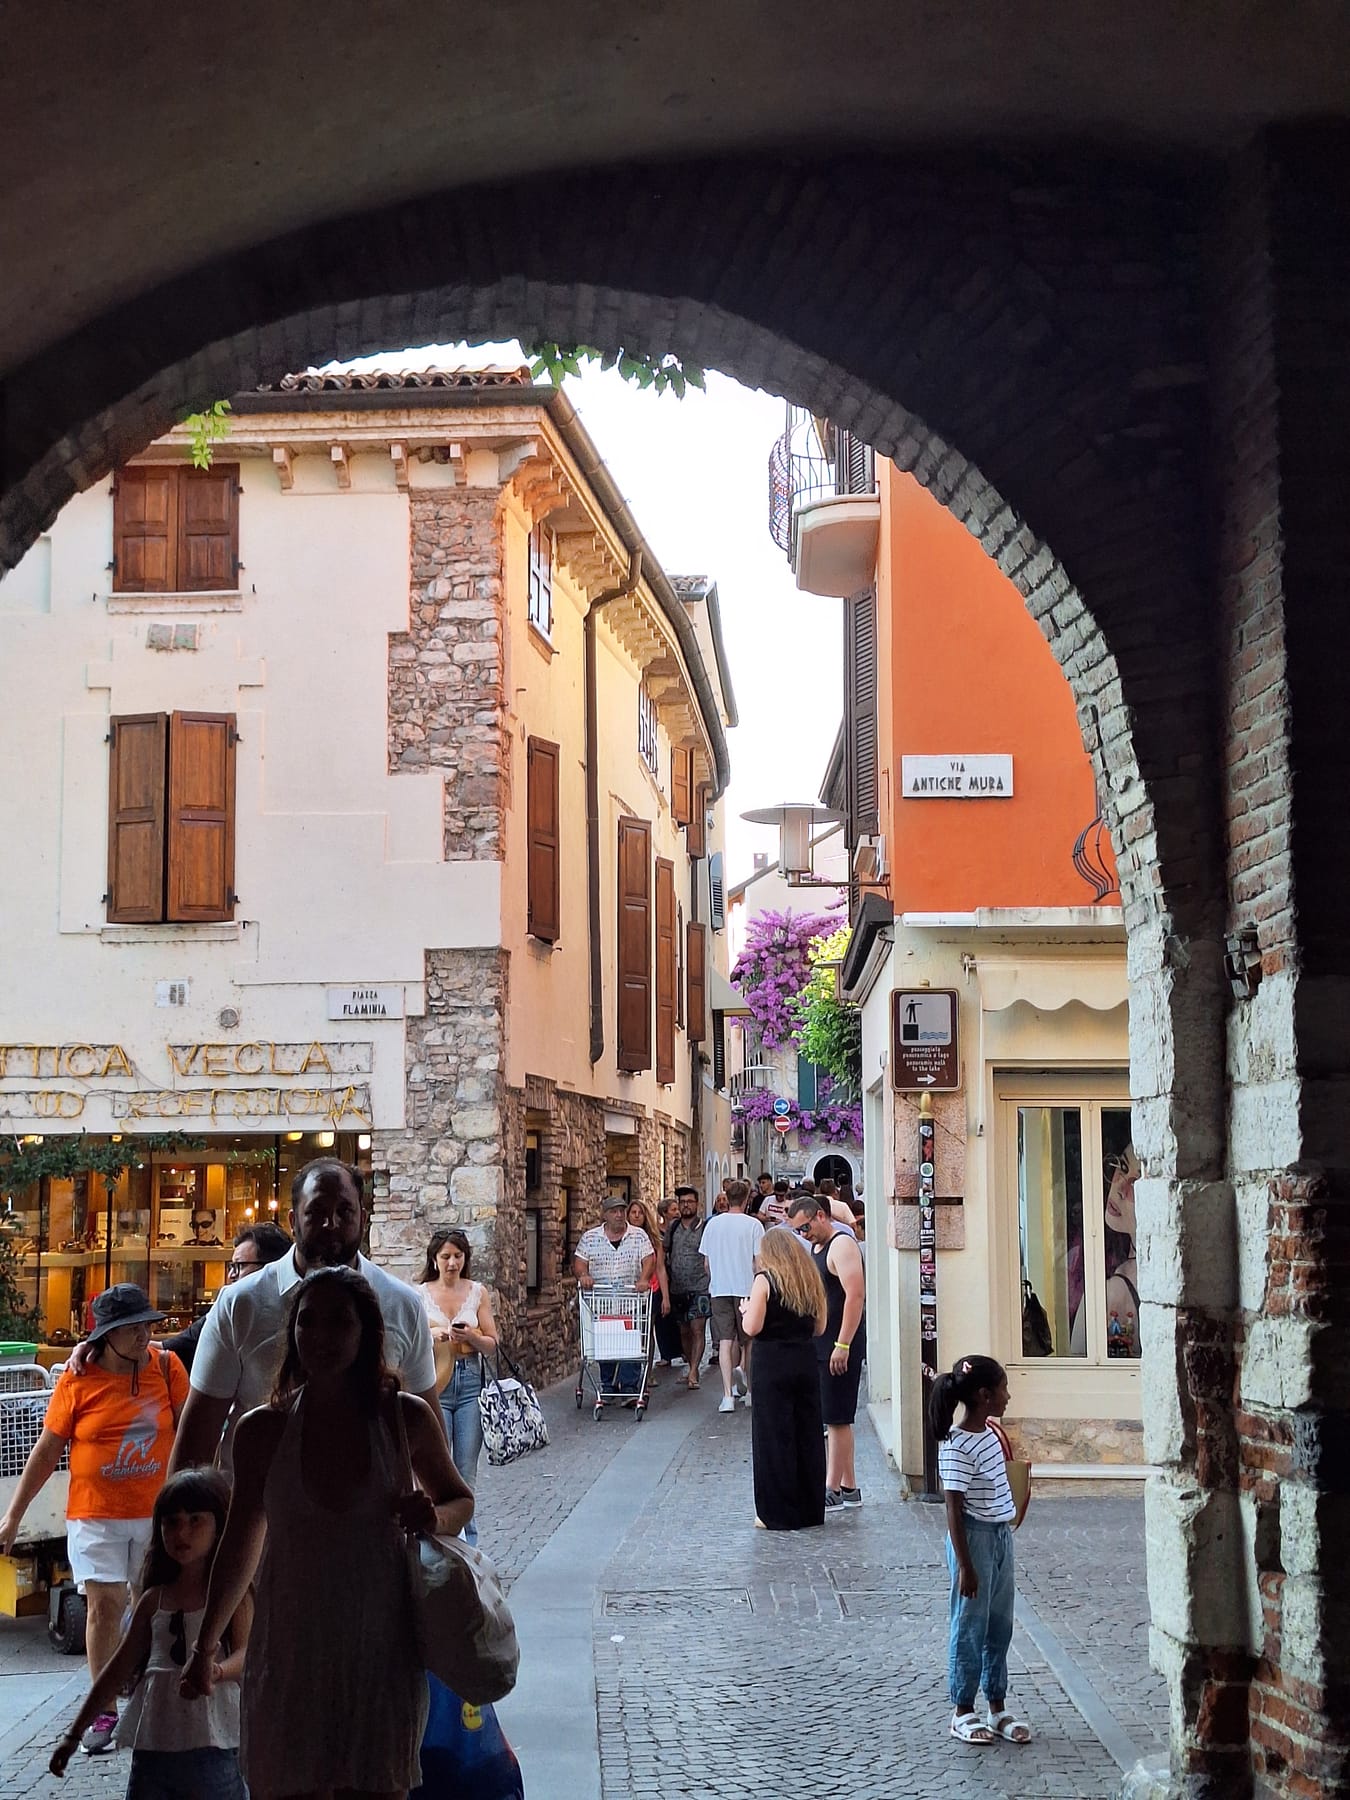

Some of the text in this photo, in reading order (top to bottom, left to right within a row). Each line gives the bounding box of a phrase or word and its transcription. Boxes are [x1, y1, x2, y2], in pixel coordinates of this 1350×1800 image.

[950, 762, 965, 772] VIA
[912, 776, 1004, 791] ANTICHE MURA
[352, 990, 378, 1000] PIAZZA
[343, 1004, 387, 1015] FLAMINIA
